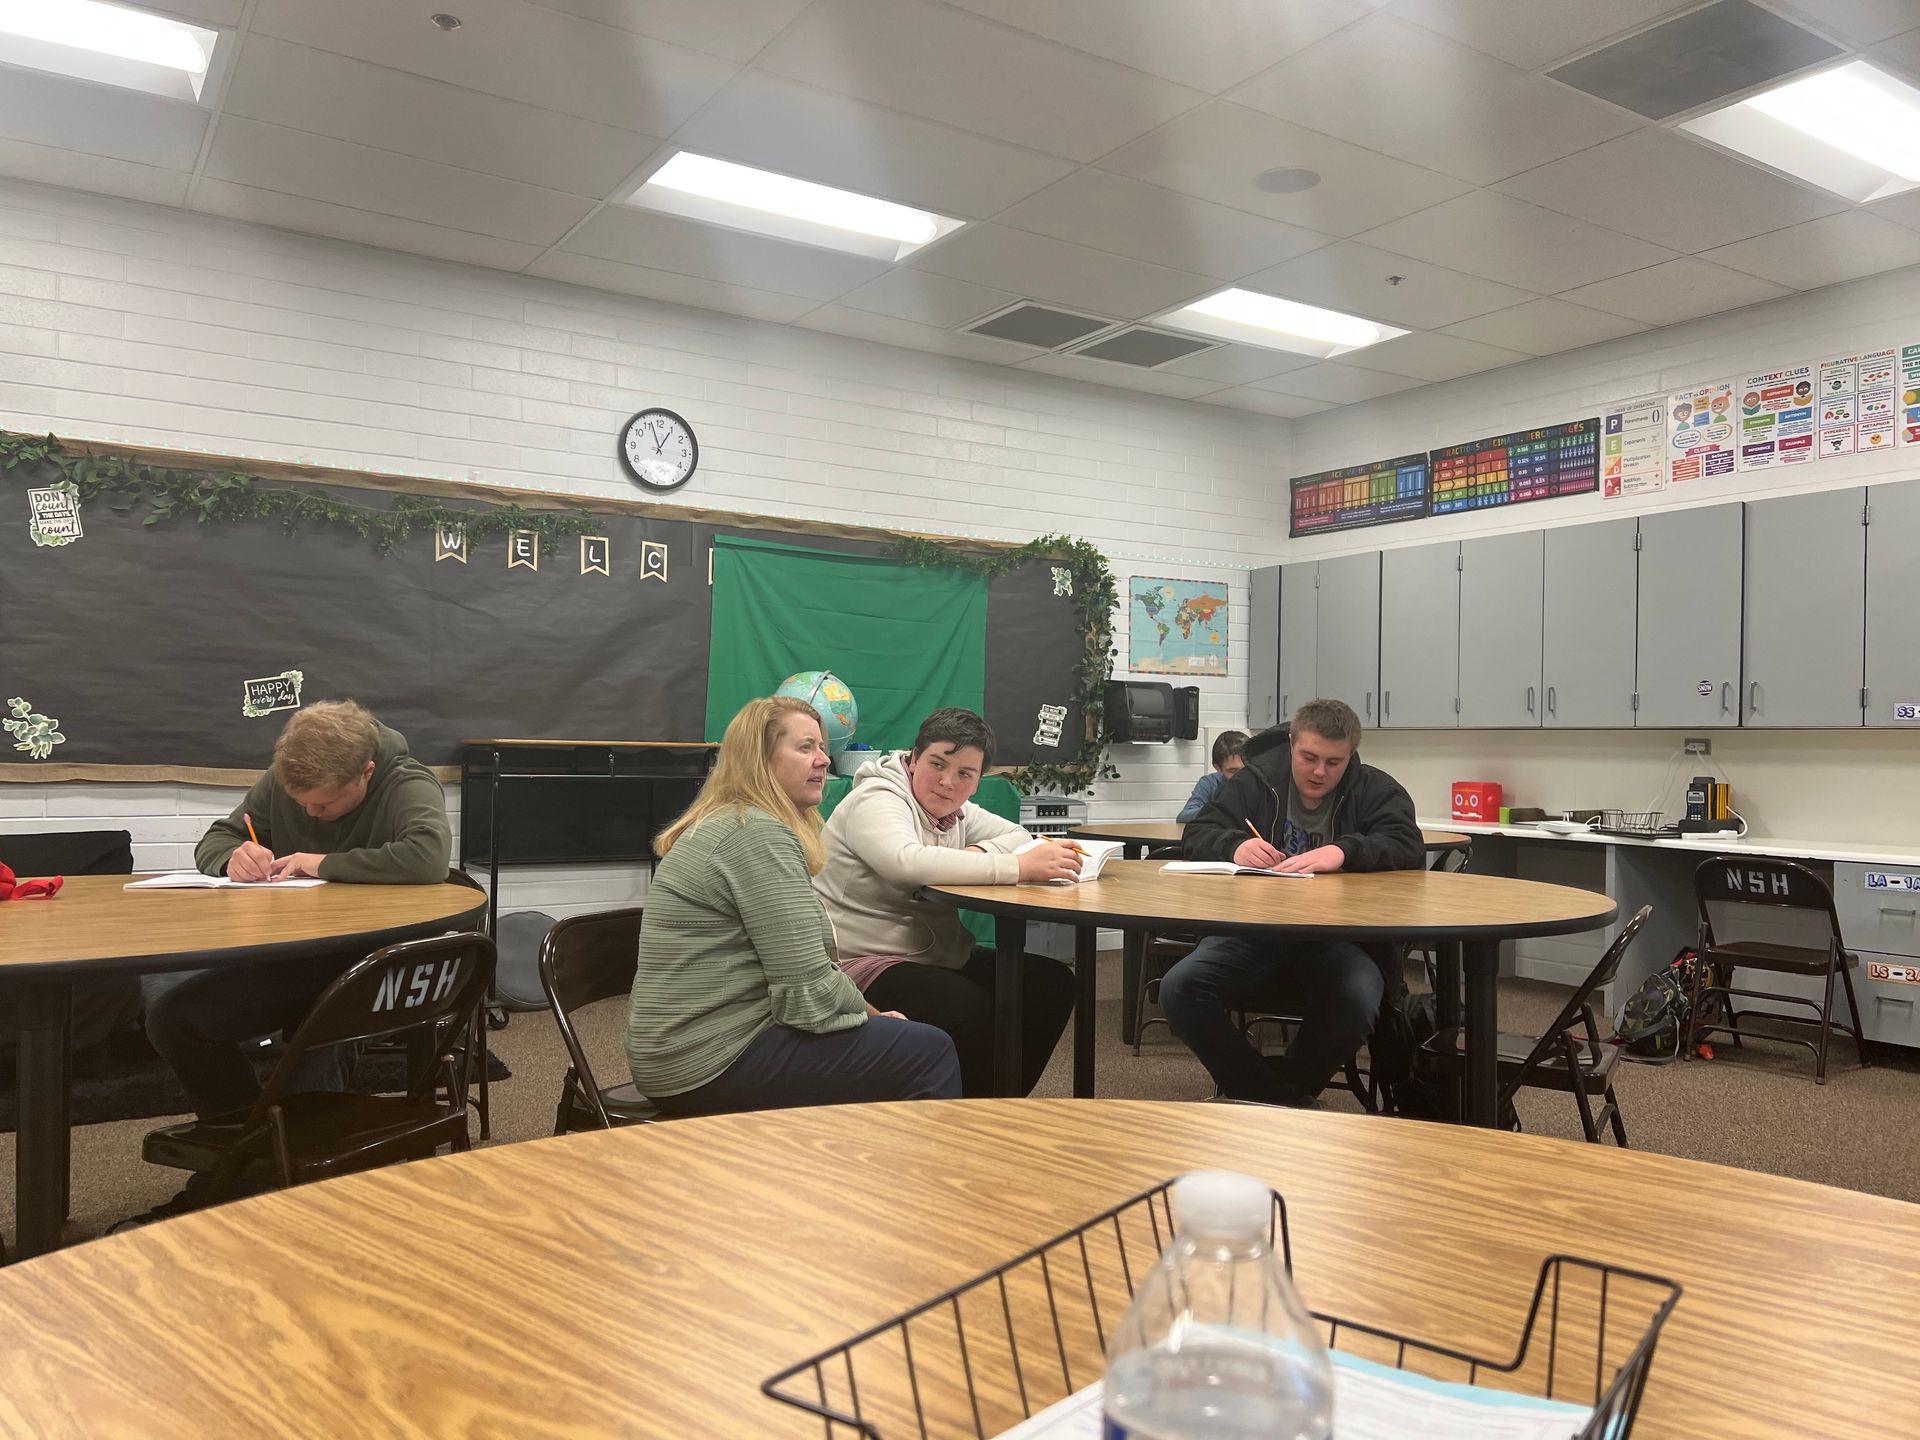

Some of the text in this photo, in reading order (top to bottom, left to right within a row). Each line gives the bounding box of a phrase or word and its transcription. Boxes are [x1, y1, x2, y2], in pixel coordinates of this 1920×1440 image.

[1821, 357, 1858, 368] FIGURATIVE
[1859, 349, 1895, 360] LANGUAGE
[1747, 372, 1782, 384] CONTEXT
[1785, 367, 1809, 376] CLUES
[1675, 393, 1693, 401] FACT
[1699, 384, 1730, 396] OPINION
[656, 420, 664, 428] 12
[1611, 419, 1617, 430] P
[636, 429, 684, 444] 10 2
[630, 441, 687, 457] 9 3
[1611, 440, 1616, 450] E
[634, 455, 639, 463] 8
[1614, 466, 1619, 474] D
[1614, 486, 1619, 494] S
[251, 681, 290, 695] HAPPY
[252, 690, 294, 707] every day
[1898, 706, 1915, 718] SS
[1726, 867, 1789, 895] NSH
[1868, 874, 1887, 887] LA
[1870, 965, 1889, 979] LS
[372, 958, 461, 1012] NSH
